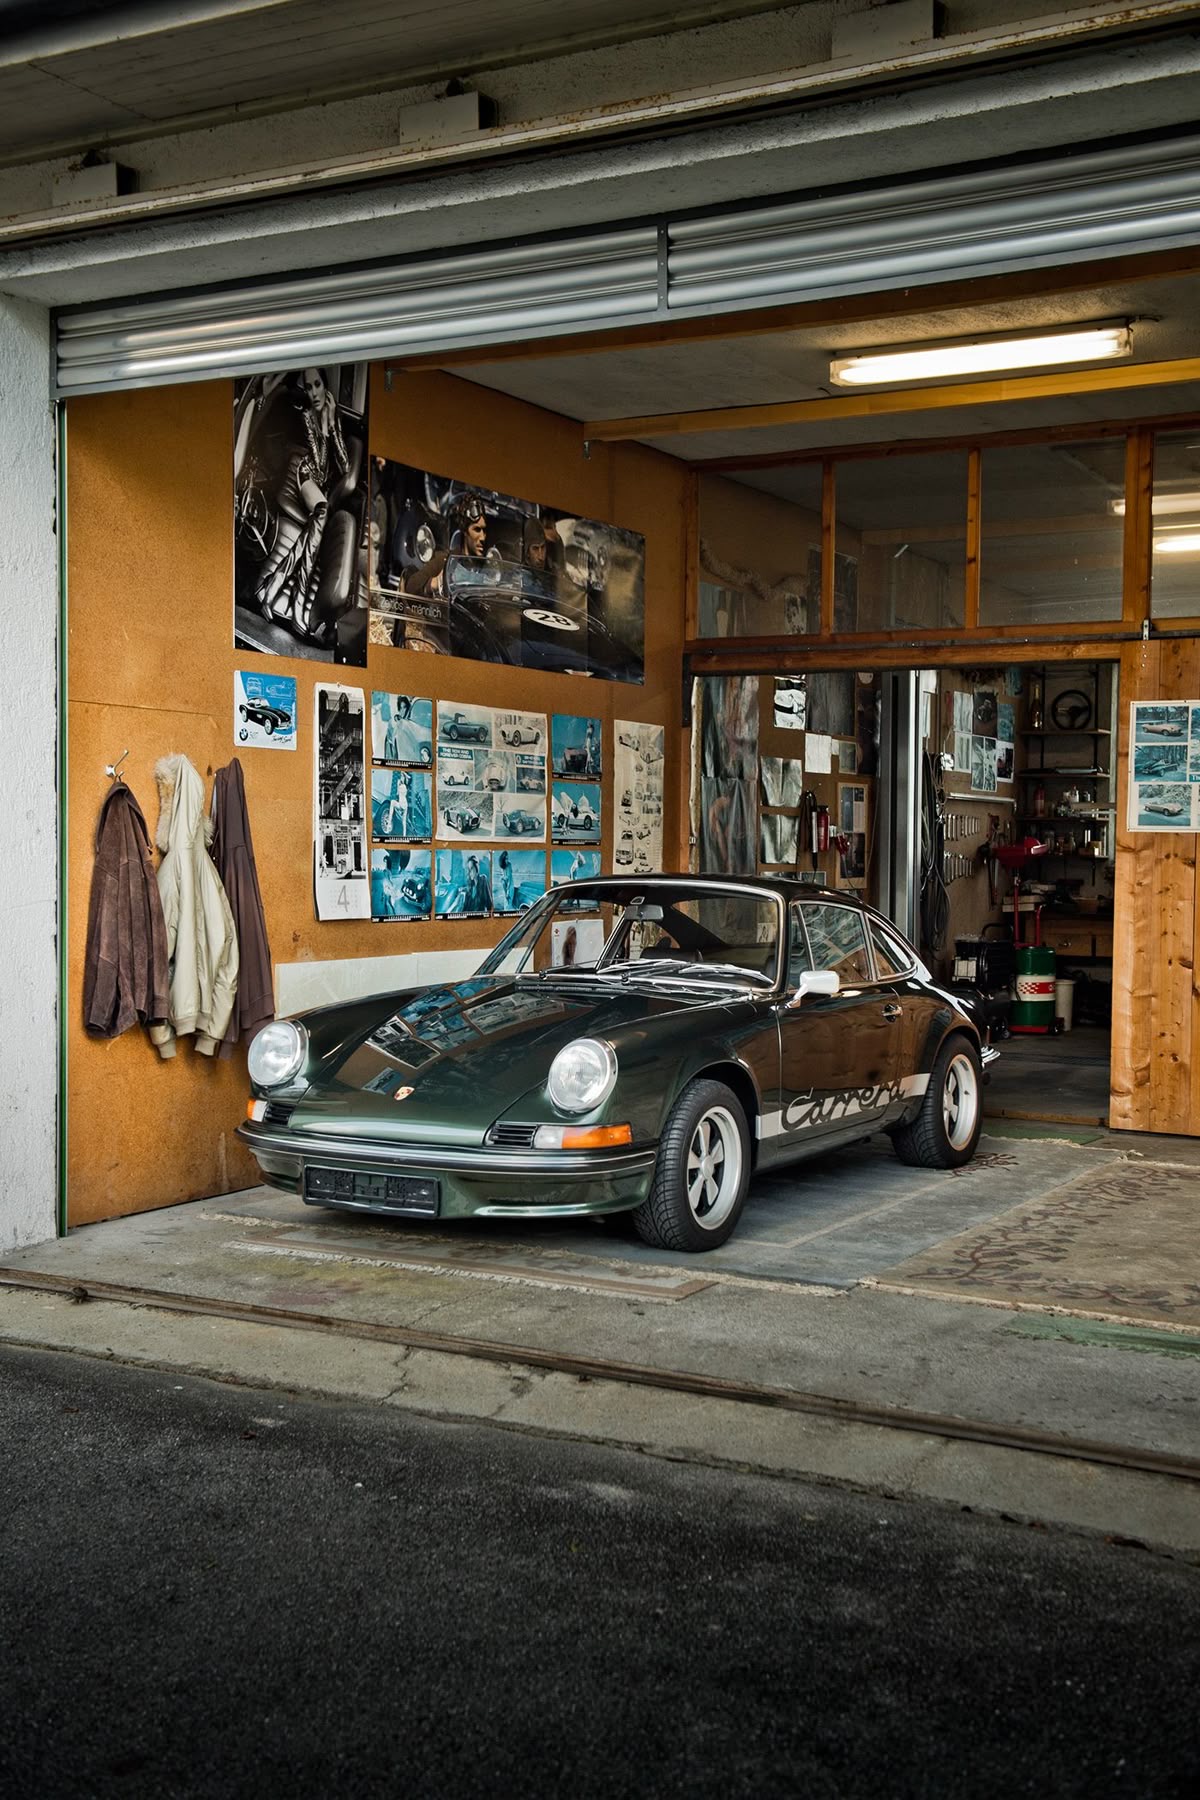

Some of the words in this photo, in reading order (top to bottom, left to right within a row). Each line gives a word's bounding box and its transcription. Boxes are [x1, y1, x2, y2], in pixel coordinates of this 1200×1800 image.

[532, 612, 571, 626] 28
[337, 884, 350, 913] 4
[781, 1079, 910, 1132] Carrera
